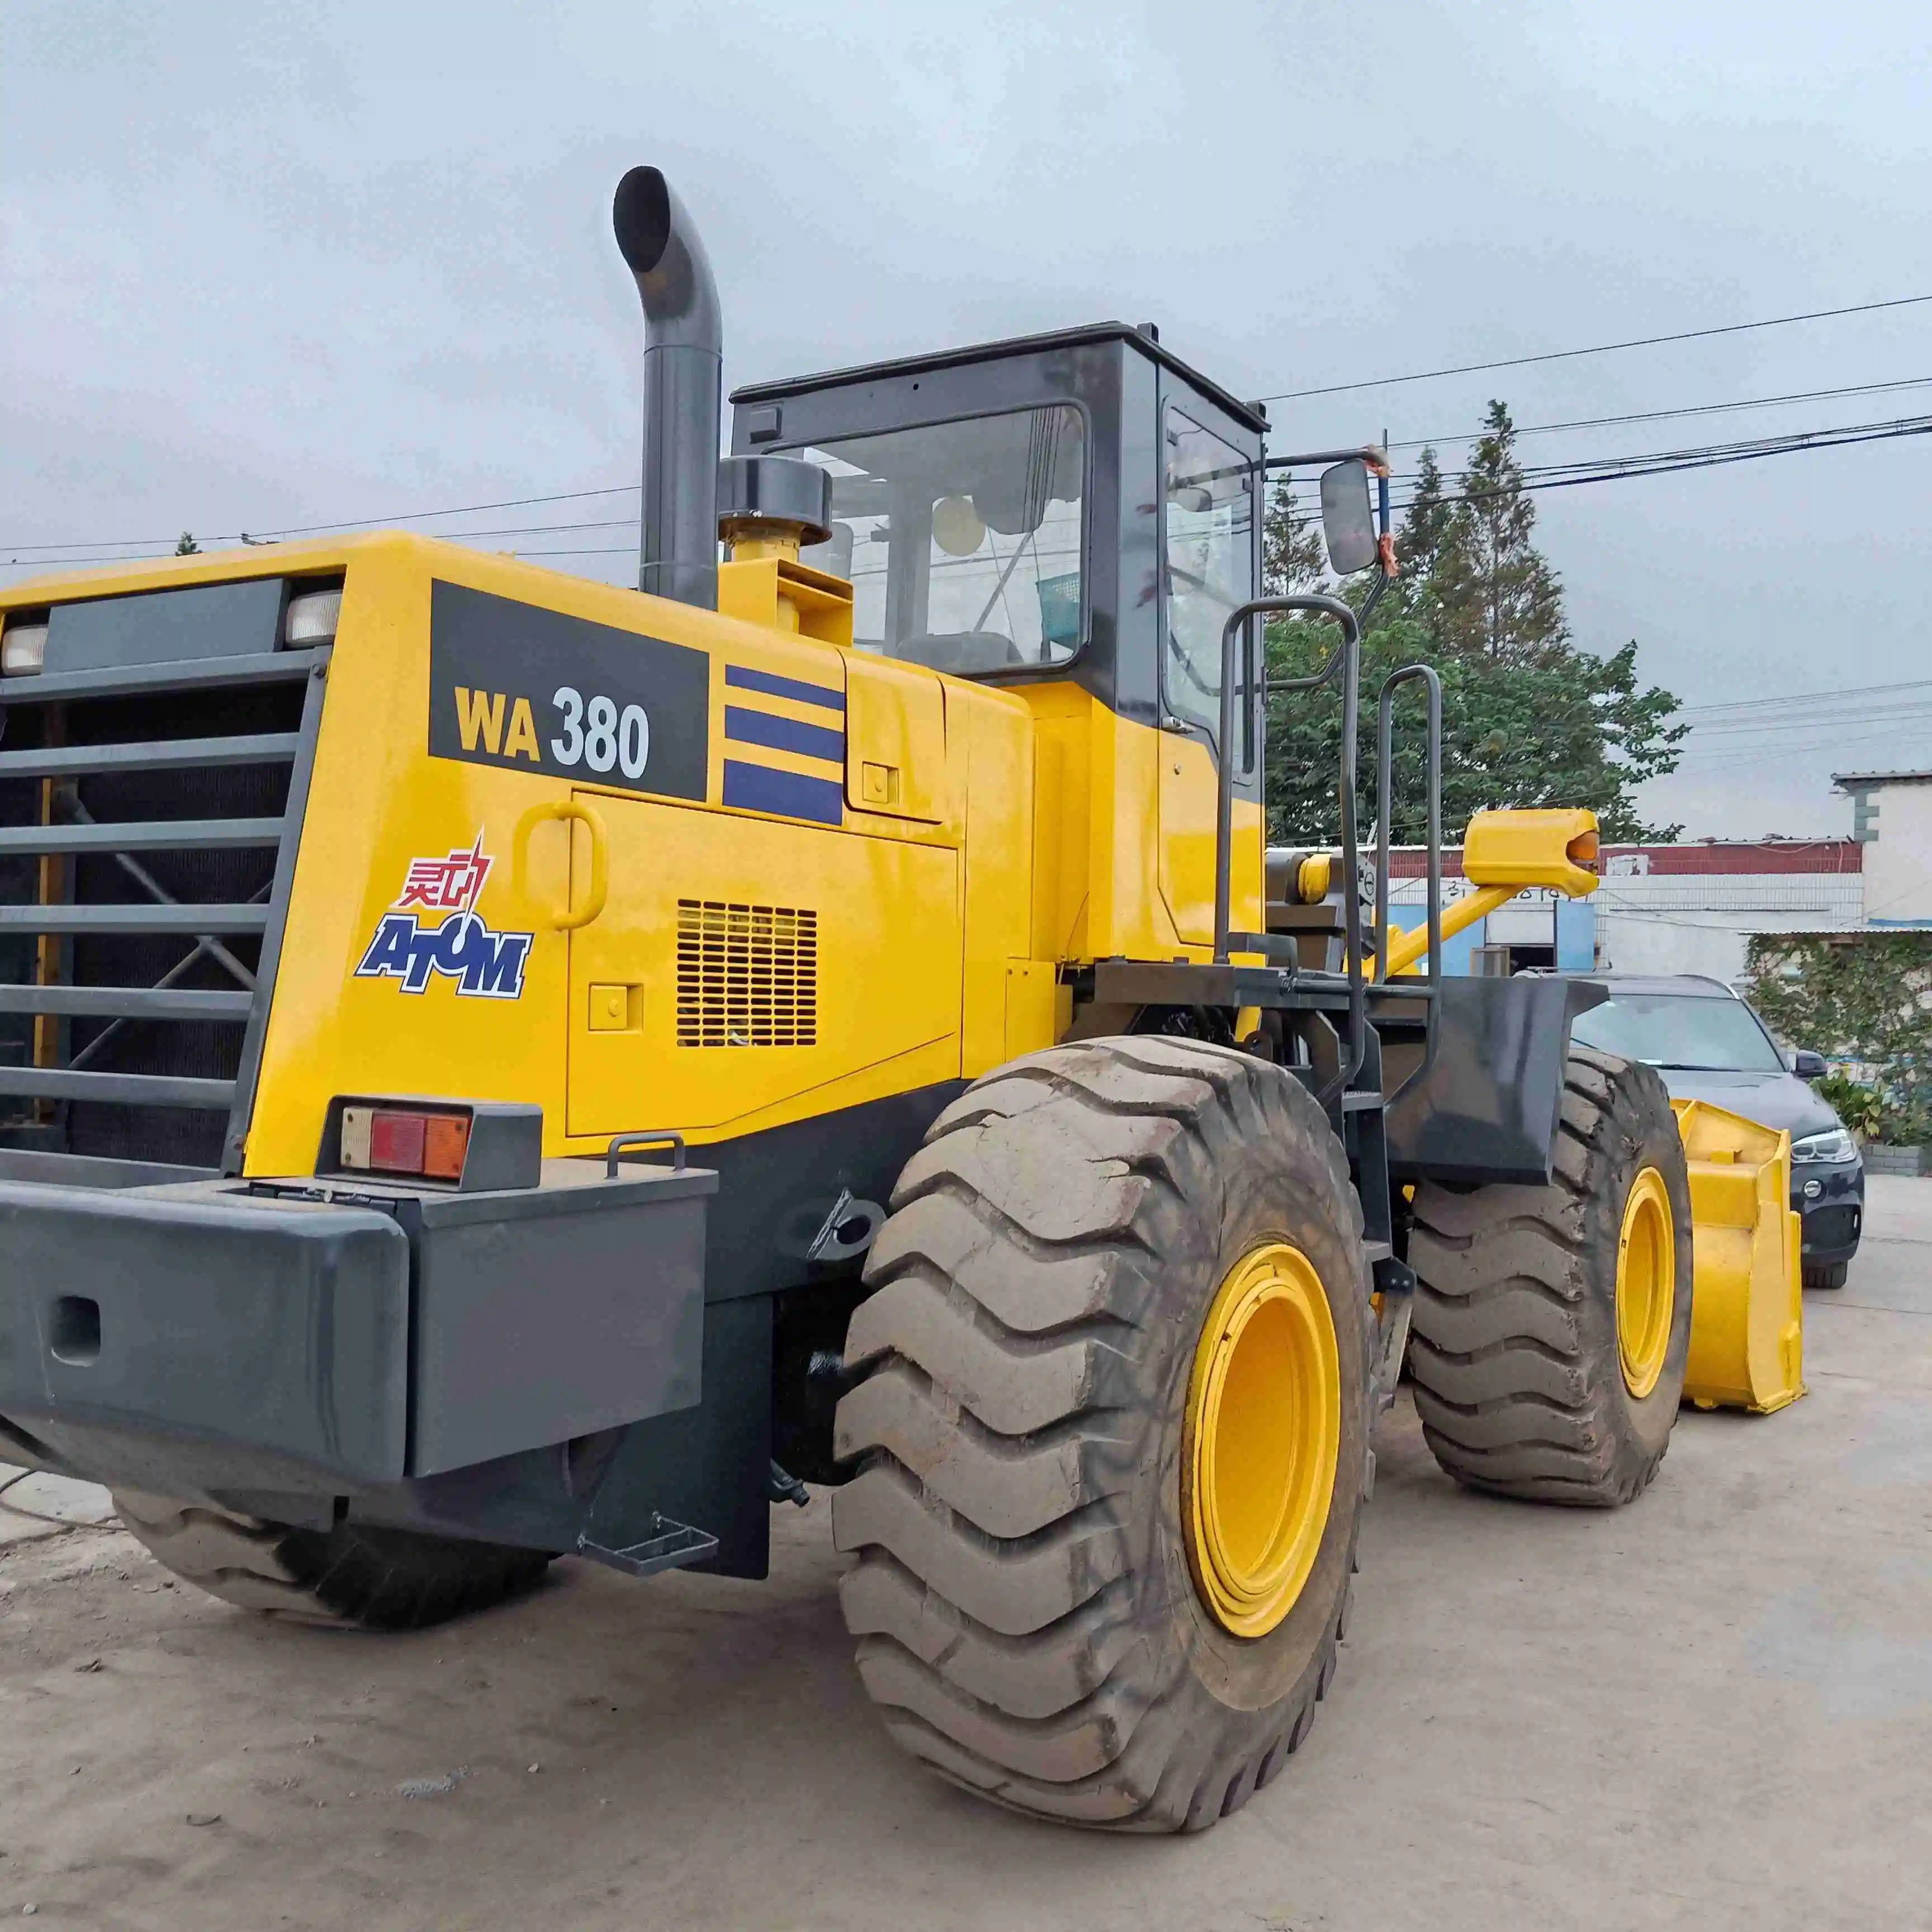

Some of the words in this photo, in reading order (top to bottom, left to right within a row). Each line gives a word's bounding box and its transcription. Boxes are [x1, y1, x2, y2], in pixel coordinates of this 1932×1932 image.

[454, 686, 541, 763] WA
[551, 686, 649, 779] 380
[354, 911, 535, 999] ATOM
